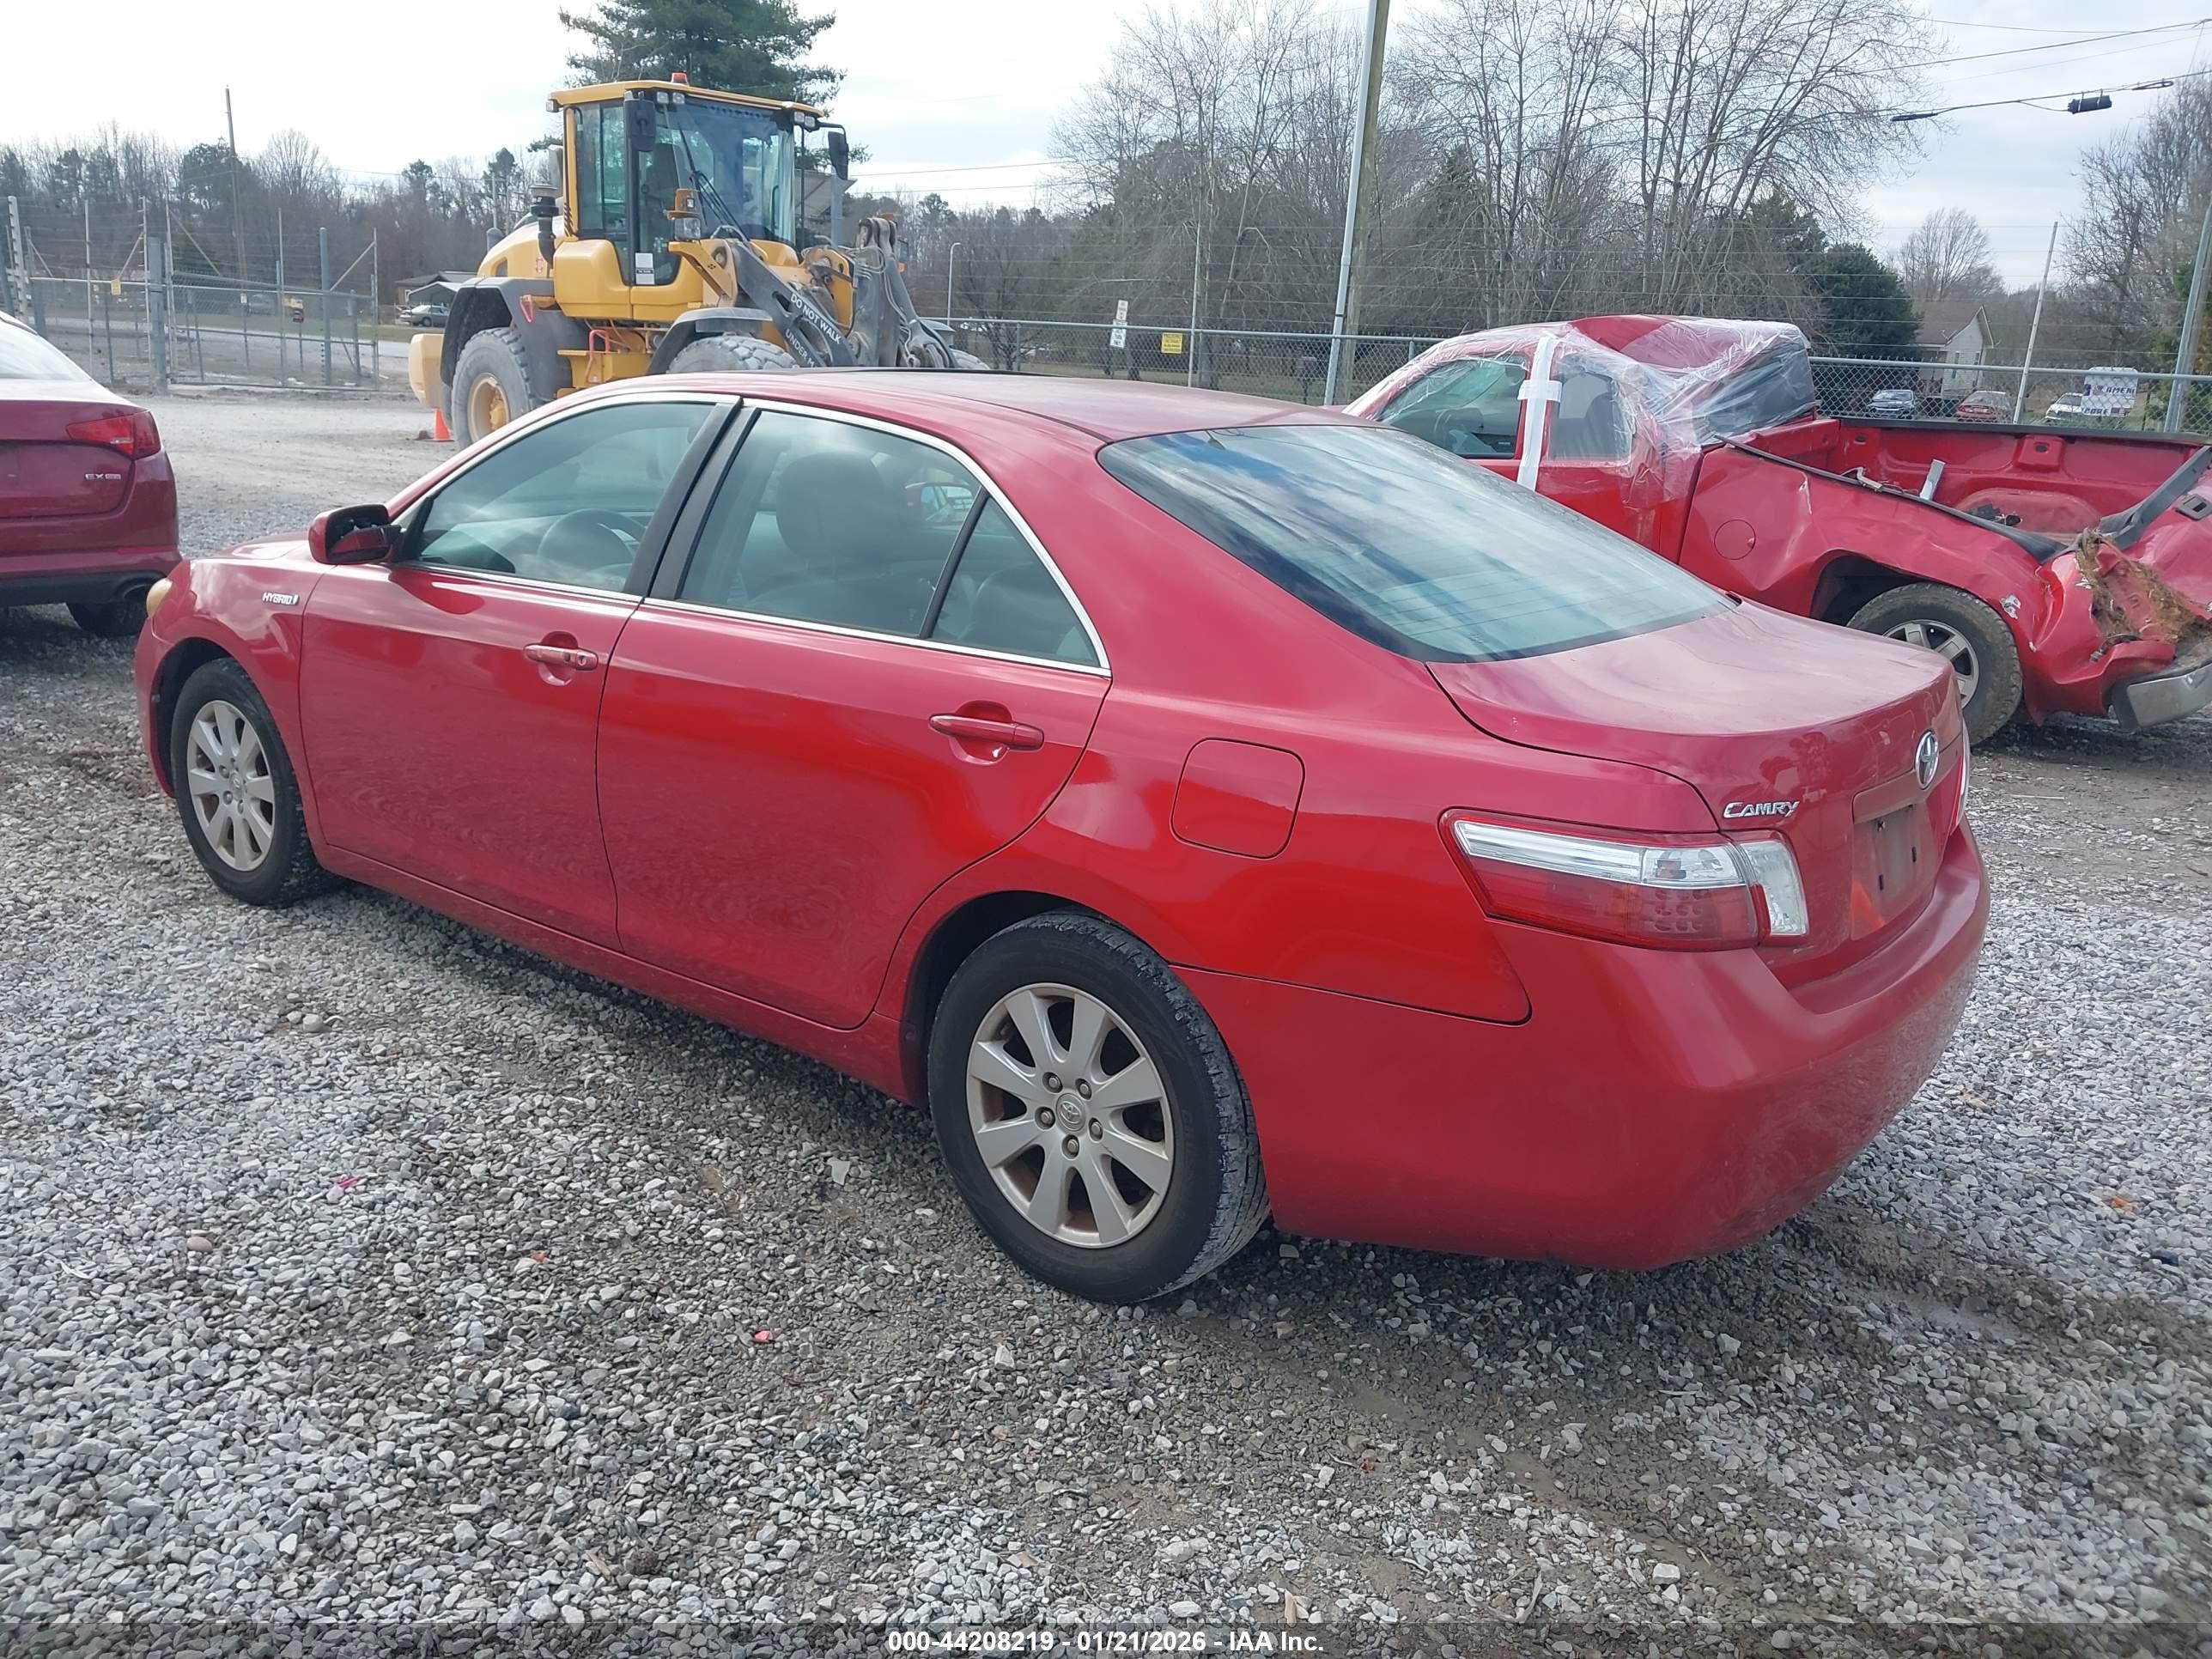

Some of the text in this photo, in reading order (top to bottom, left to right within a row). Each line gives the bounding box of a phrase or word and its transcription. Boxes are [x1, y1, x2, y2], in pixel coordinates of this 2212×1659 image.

[791, 293, 842, 344] DO NOT WALK
[785, 329, 807, 360] UNDER
[262, 592, 293, 605] HYBRID
[1723, 800, 1800, 818] CAMRY
